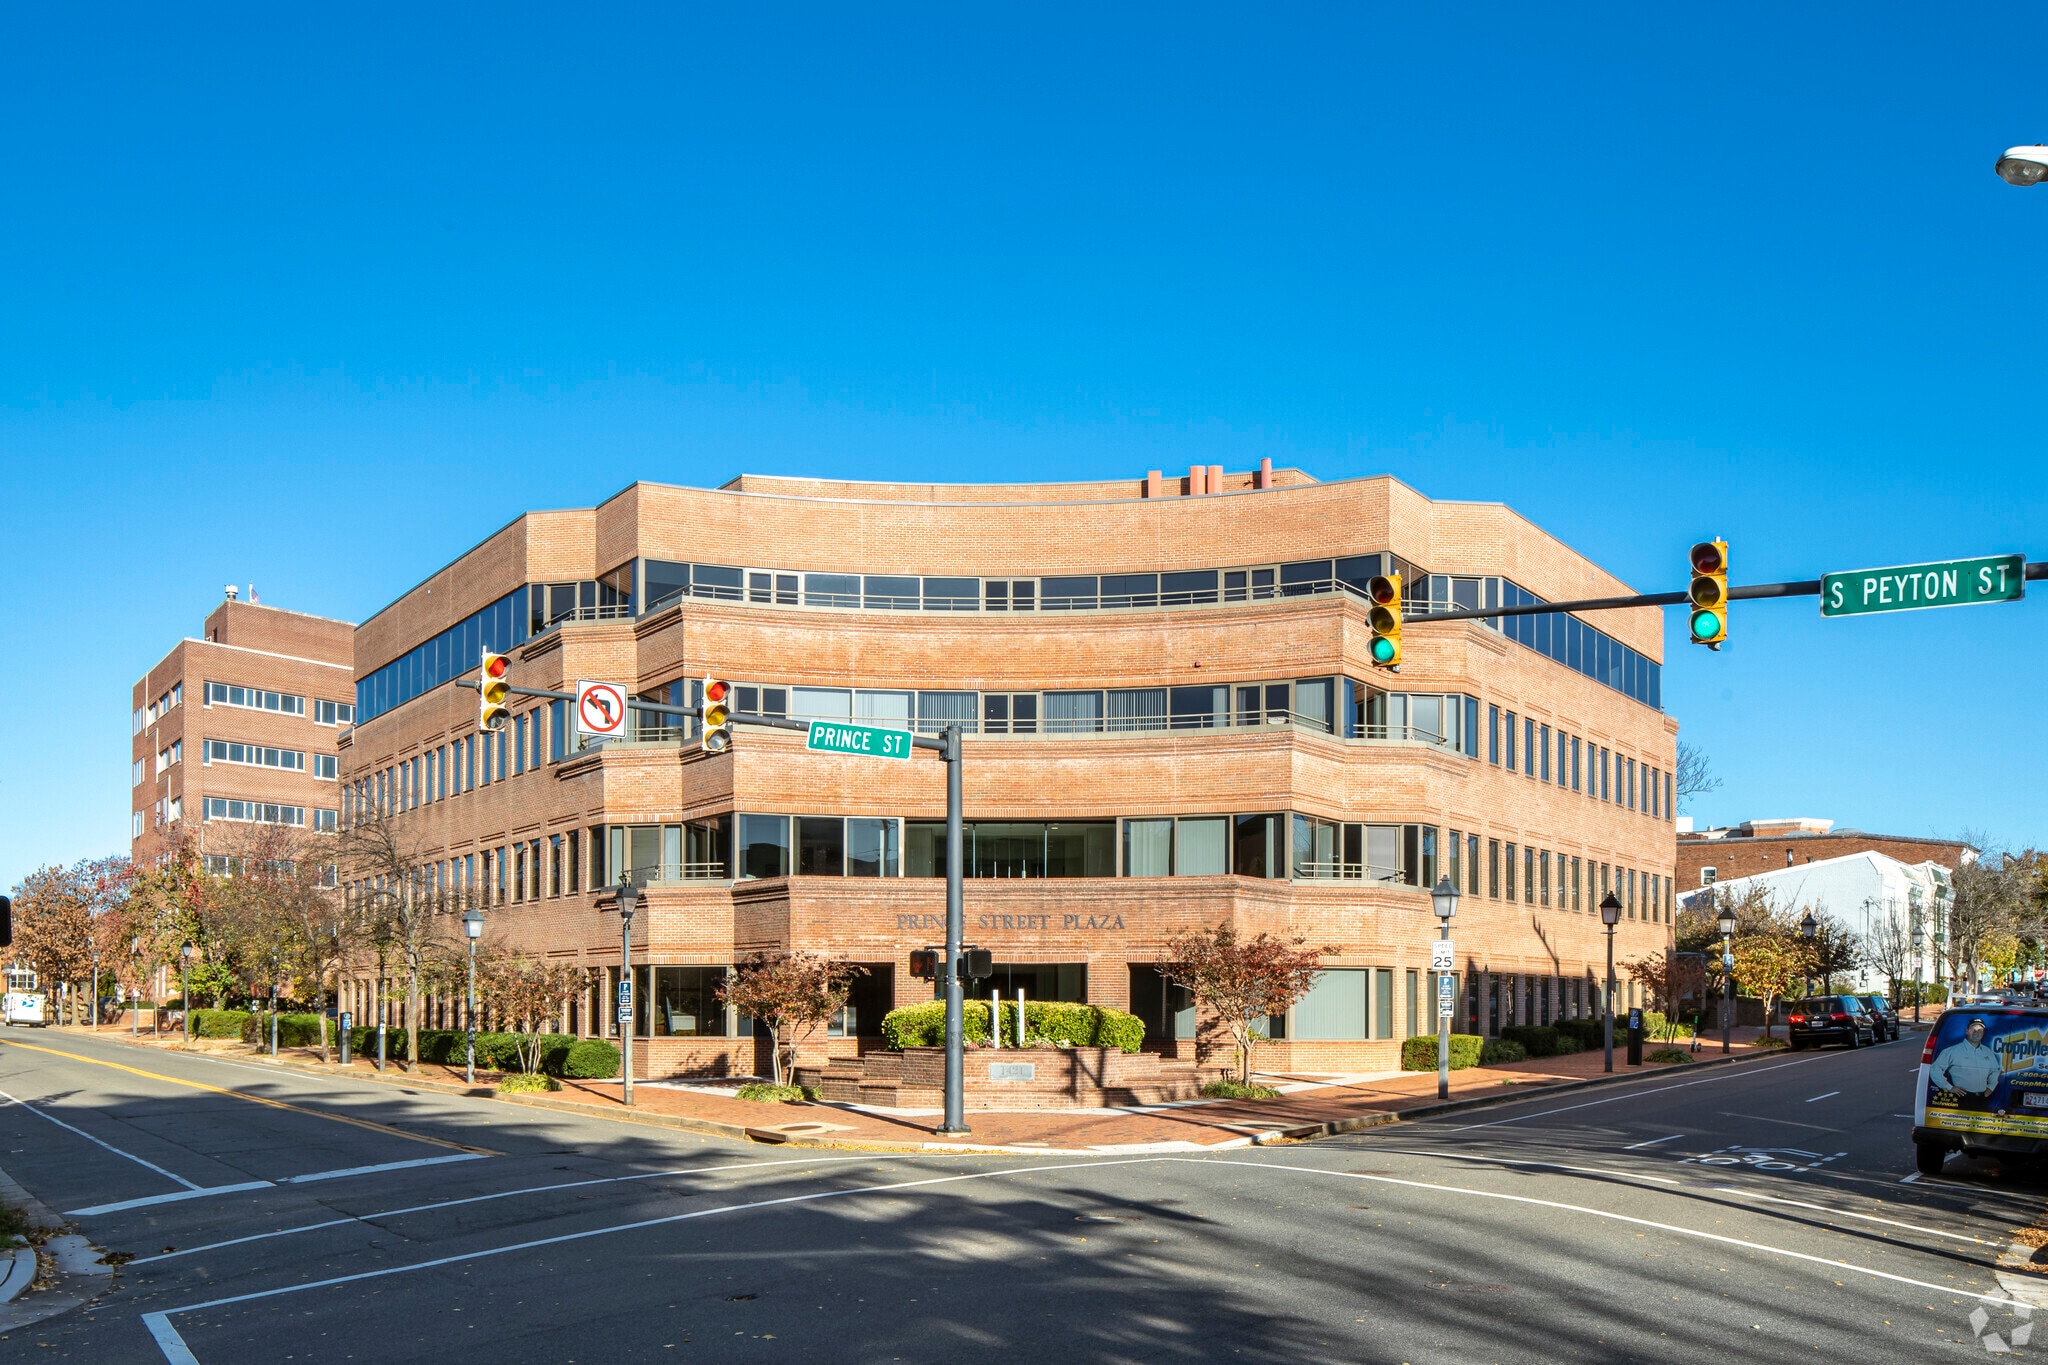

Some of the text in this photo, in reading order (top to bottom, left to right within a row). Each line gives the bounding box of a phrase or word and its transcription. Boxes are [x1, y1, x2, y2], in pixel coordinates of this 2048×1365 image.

[1831, 564, 2010, 609] S PEYTON ST
[813, 726, 903, 754] PRINCE ST
[897, 914, 1125, 930] PRIN STREET PLAZA
[1434, 956, 1452, 968] 25
[2017, 1071, 2048, 1079] 1-800-G
